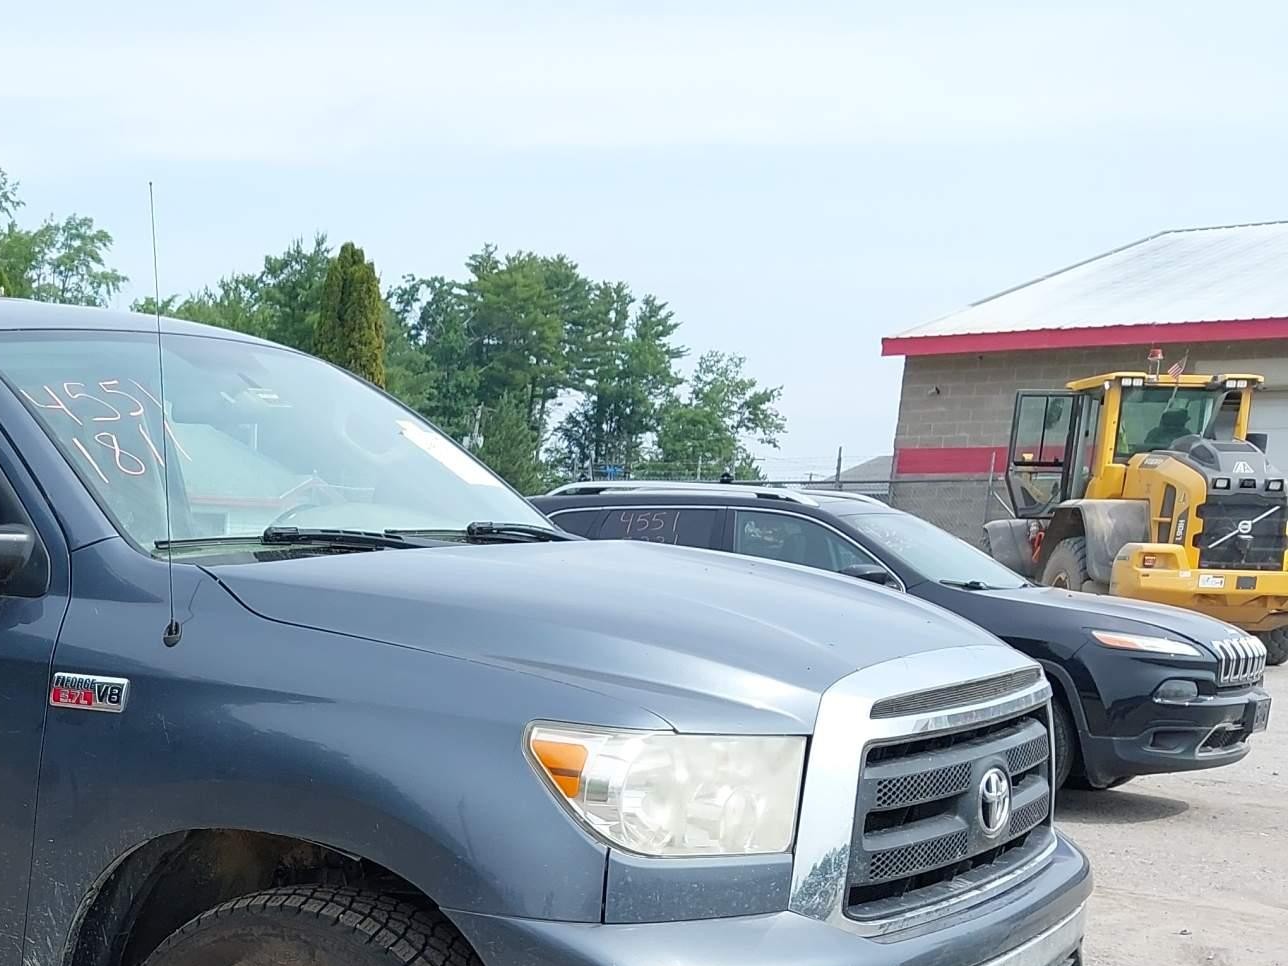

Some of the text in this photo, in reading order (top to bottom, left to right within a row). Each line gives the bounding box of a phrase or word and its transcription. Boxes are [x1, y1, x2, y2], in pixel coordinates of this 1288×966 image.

[20, 378, 168, 426] 4551
[620, 511, 680, 534] 4551
[95, 682, 123, 706] V8
